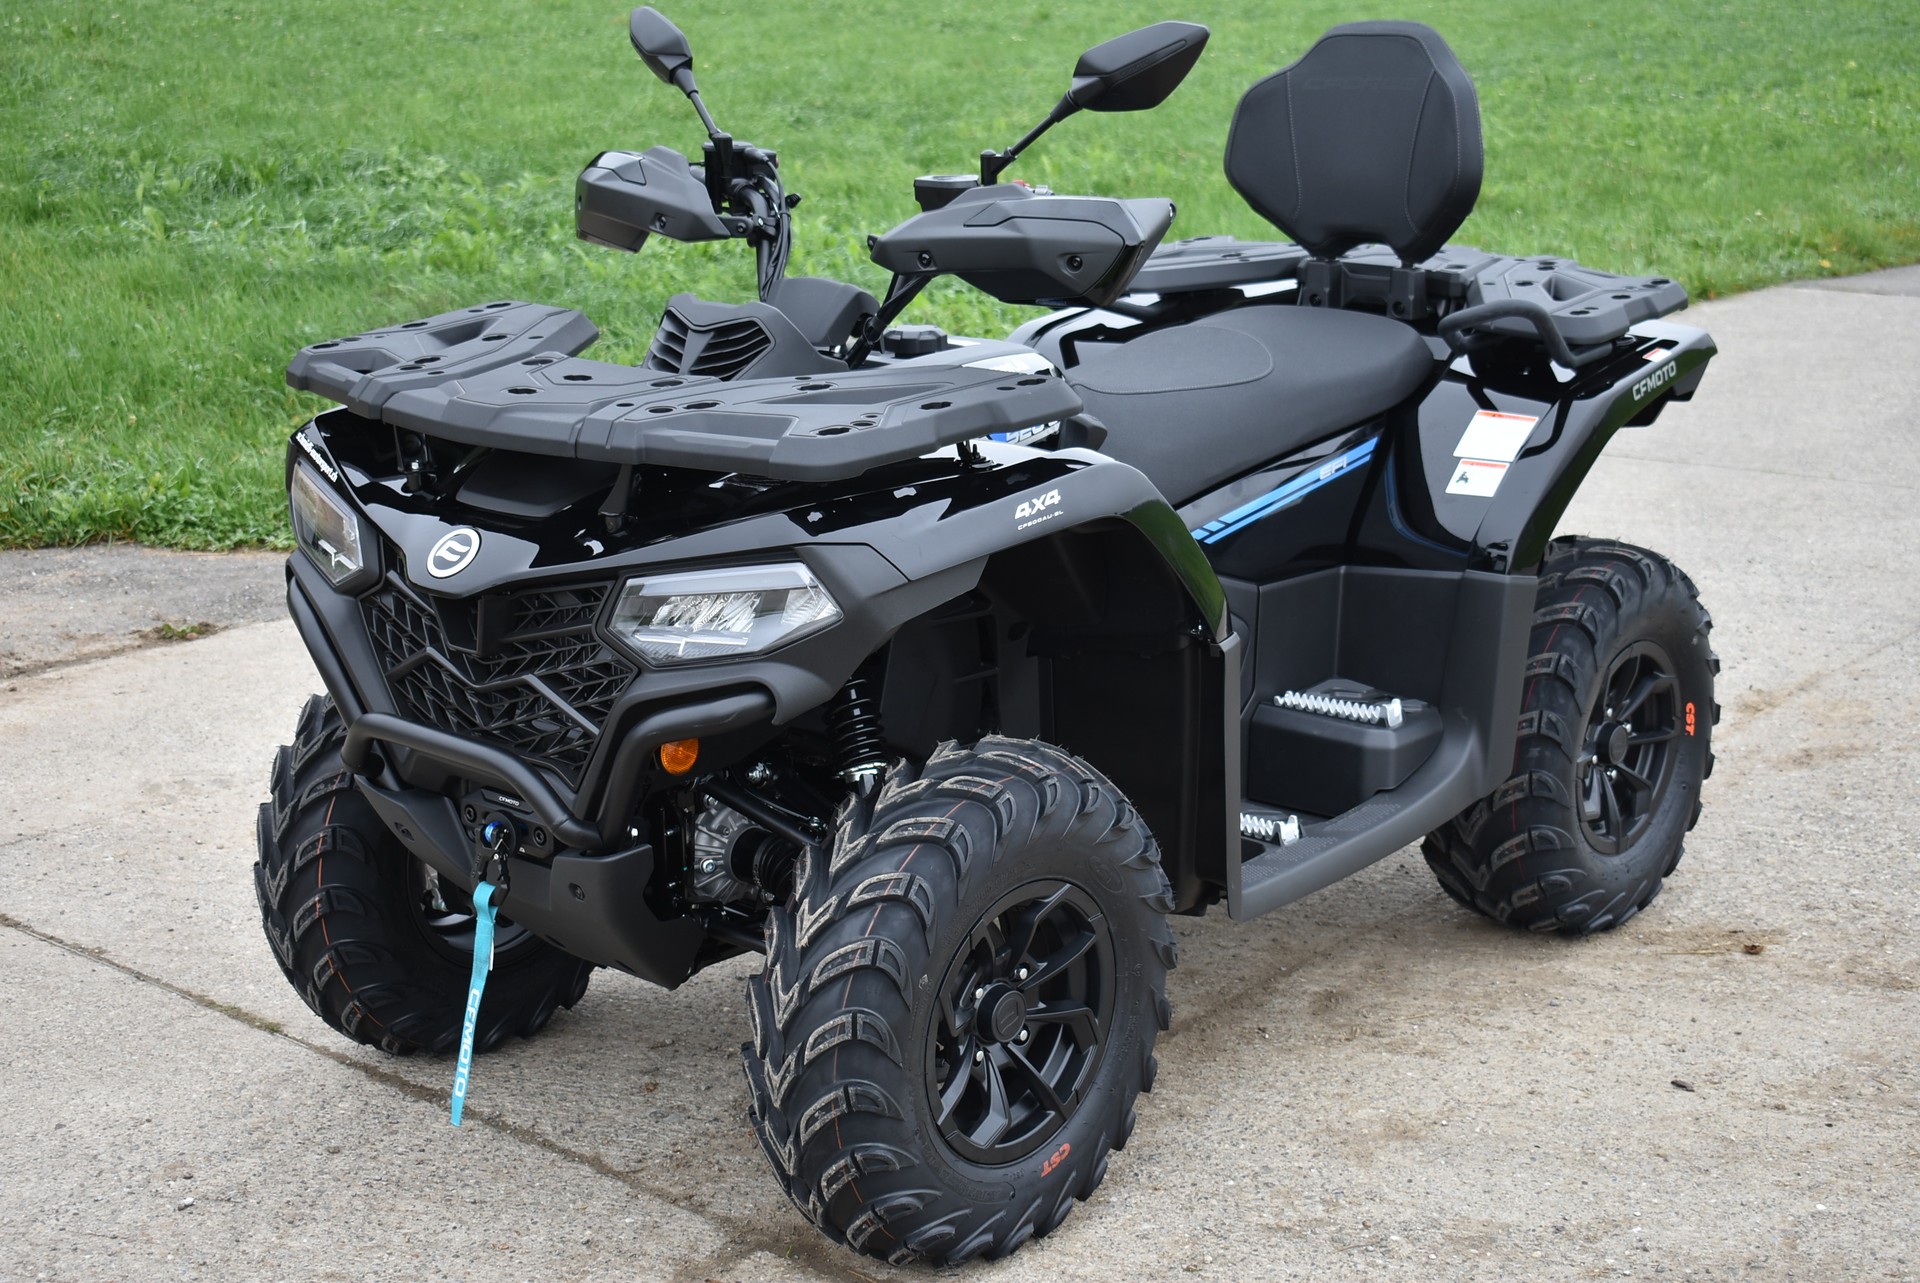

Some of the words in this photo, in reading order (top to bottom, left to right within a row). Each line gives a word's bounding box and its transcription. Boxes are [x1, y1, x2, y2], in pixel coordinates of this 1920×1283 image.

[1632, 361, 1677, 401] CFMOTO
[1319, 456, 1347, 480] EFI
[1685, 702, 1695, 737] CST
[455, 988, 480, 1098] CFMOTO
[1040, 1142, 1071, 1178] CST
